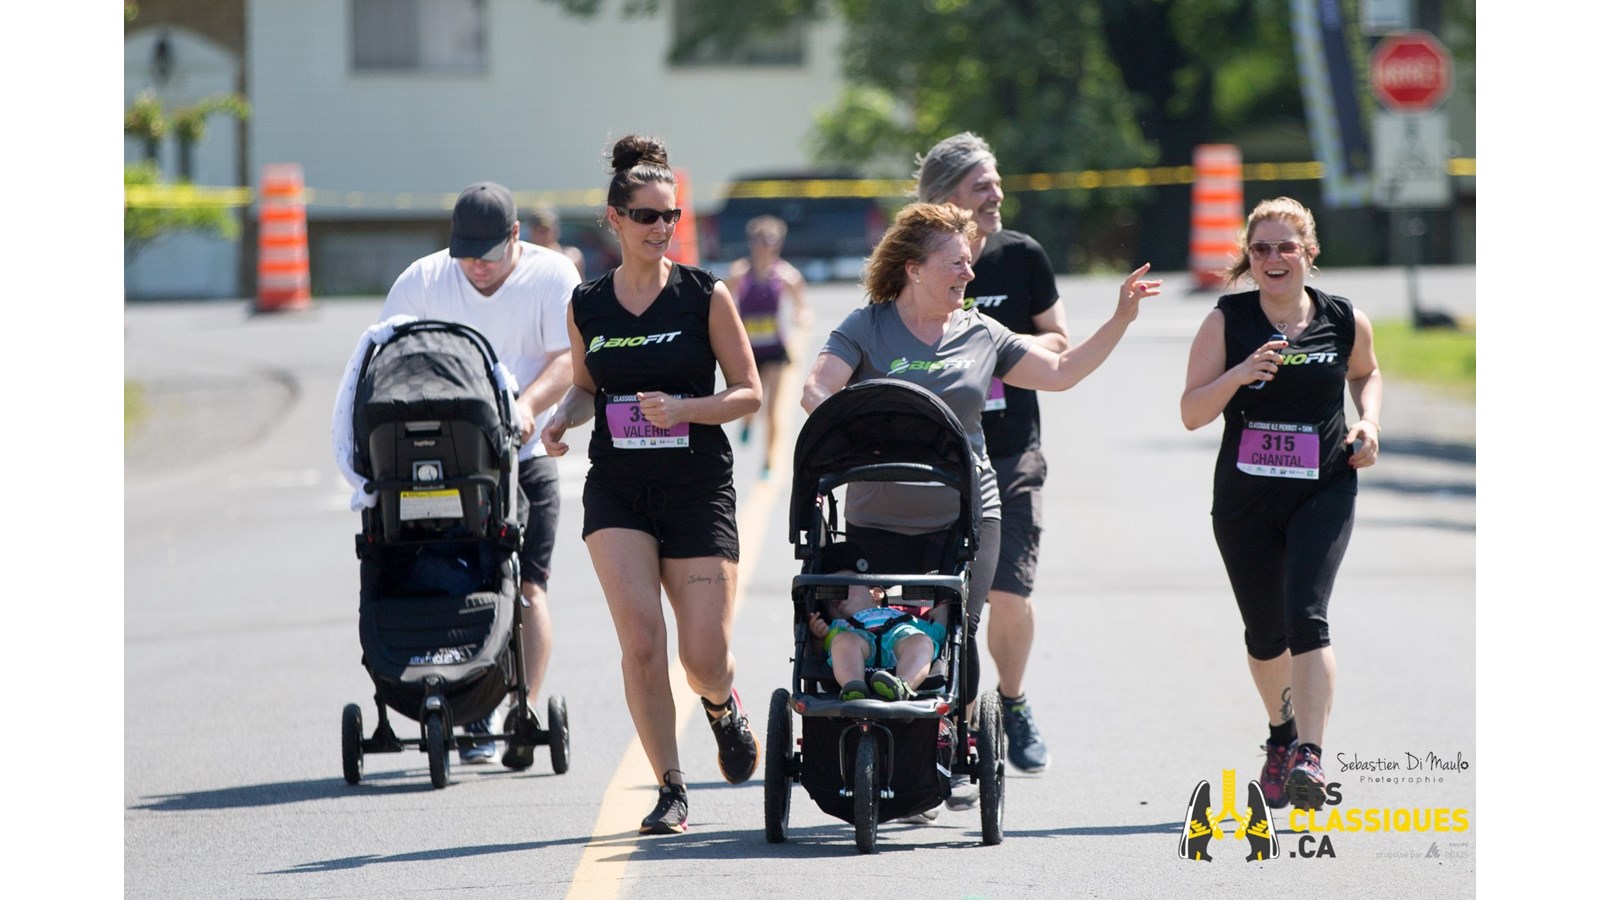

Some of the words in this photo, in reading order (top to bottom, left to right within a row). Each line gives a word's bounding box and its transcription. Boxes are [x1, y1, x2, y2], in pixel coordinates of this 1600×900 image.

[963, 295, 1008, 310] OFIT
[603, 331, 682, 348] BIOFIT
[908, 359, 975, 370] BIOFIT
[1279, 352, 1338, 365] IOFIT
[623, 425, 671, 438] VALERIE
[1262, 433, 1295, 452] 315
[1251, 452, 1305, 467] CHANTAL
